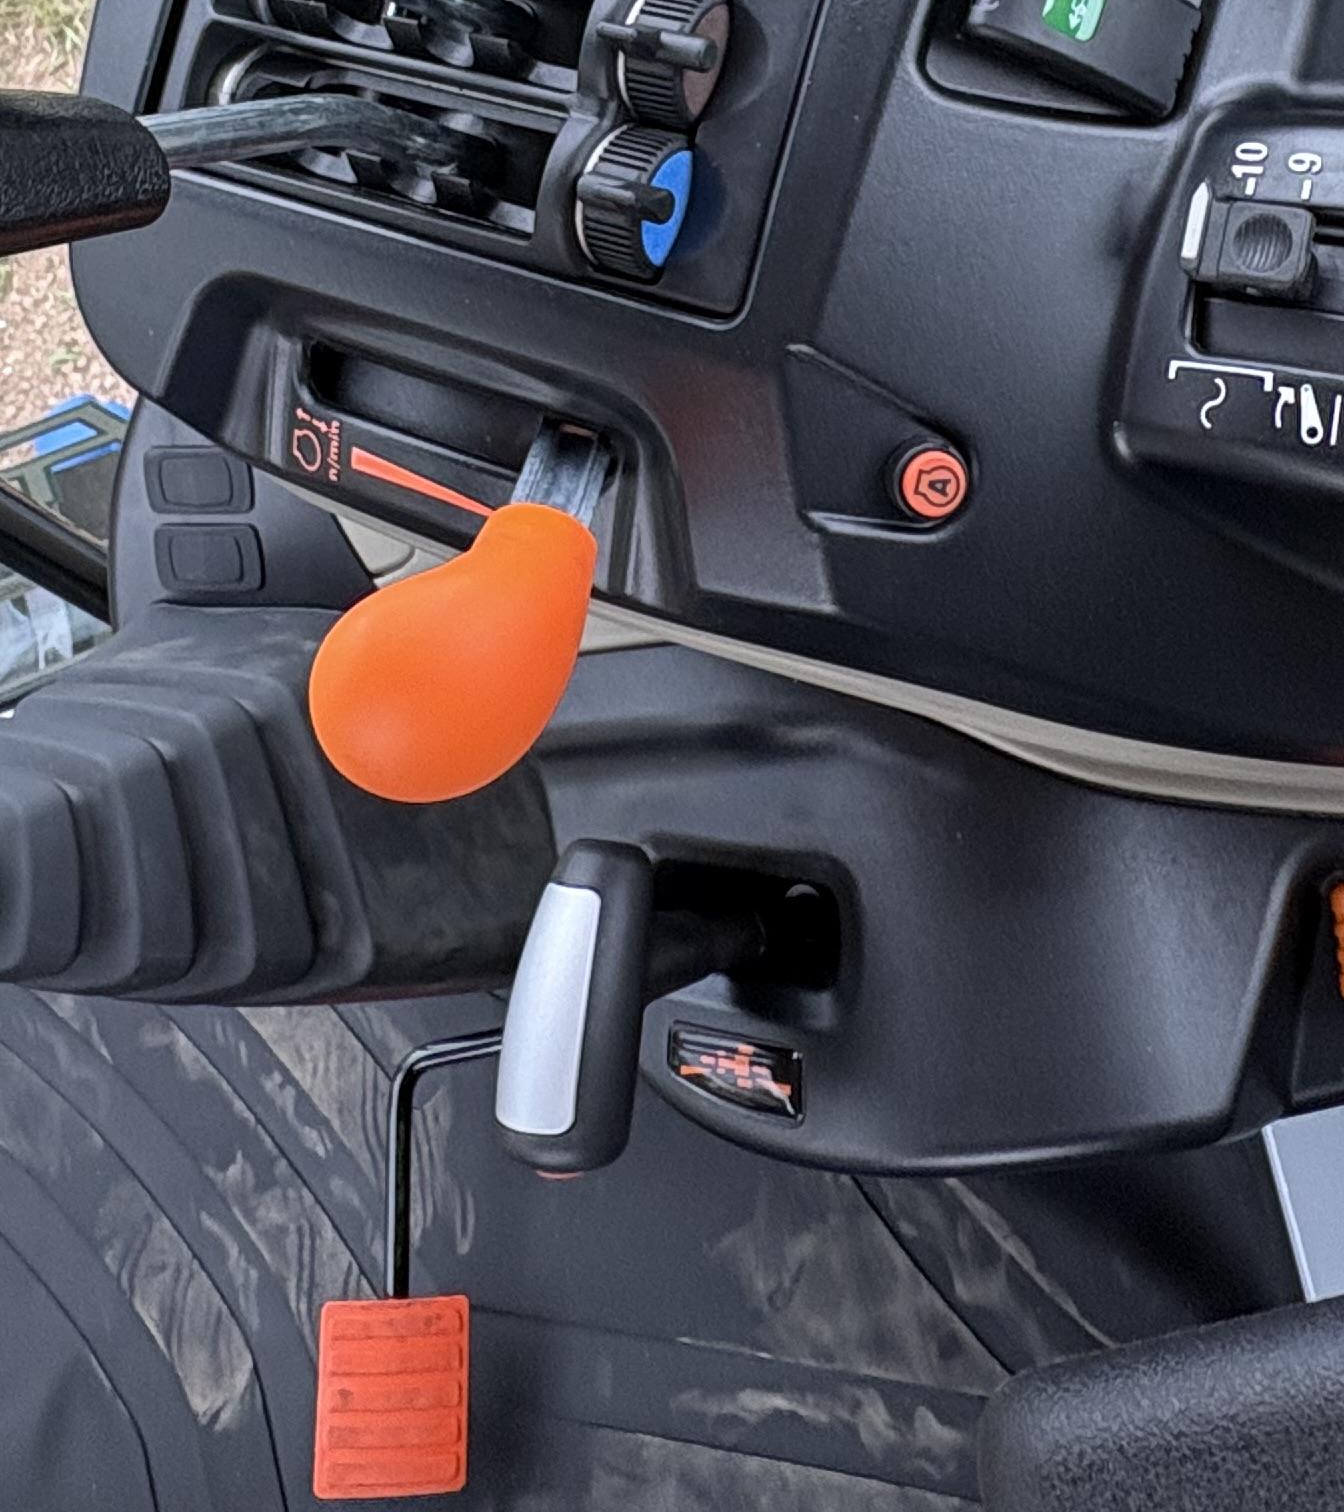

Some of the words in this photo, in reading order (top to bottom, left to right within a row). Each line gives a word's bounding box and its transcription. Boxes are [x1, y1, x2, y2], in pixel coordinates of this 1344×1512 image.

[1231, 142, 1268, 178] 10
[1288, 152, 1322, 174] 9
[325, 420, 341, 482] n/min
[928, 478, 951, 498] A
